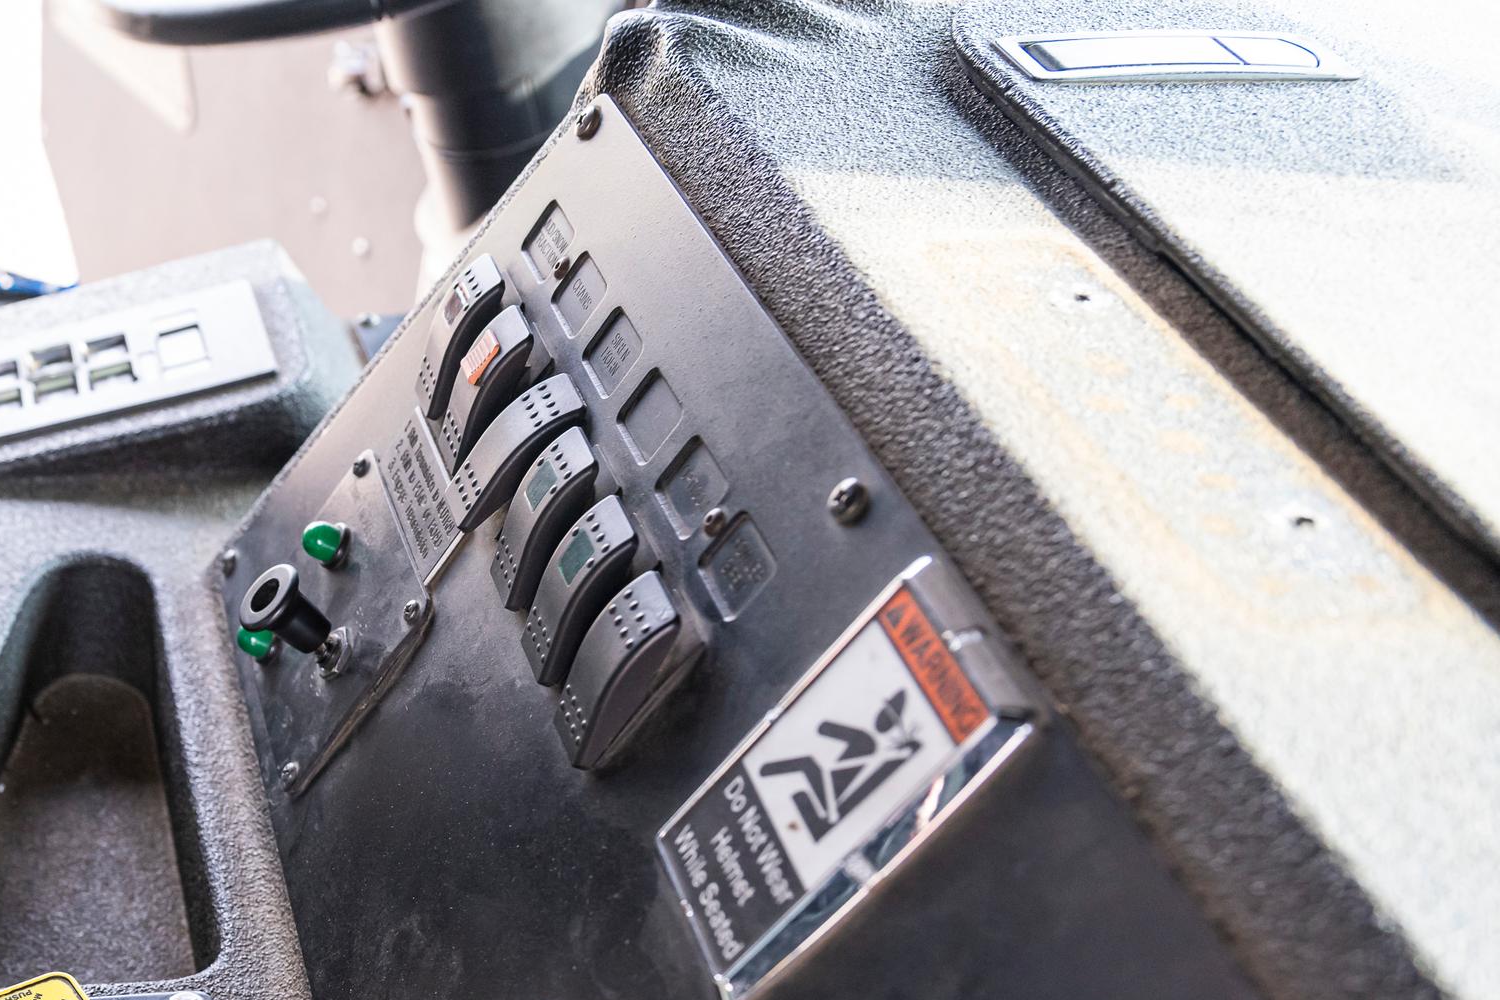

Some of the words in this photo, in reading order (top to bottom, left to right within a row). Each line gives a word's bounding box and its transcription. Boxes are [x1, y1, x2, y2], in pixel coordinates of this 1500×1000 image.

[674, 823, 708, 888] While
[699, 881, 746, 961] Seated
[709, 825, 756, 908] Helmet
[723, 774, 748, 813] Do
[737, 804, 769, 853] Not
[755, 840, 795, 906] Wear
